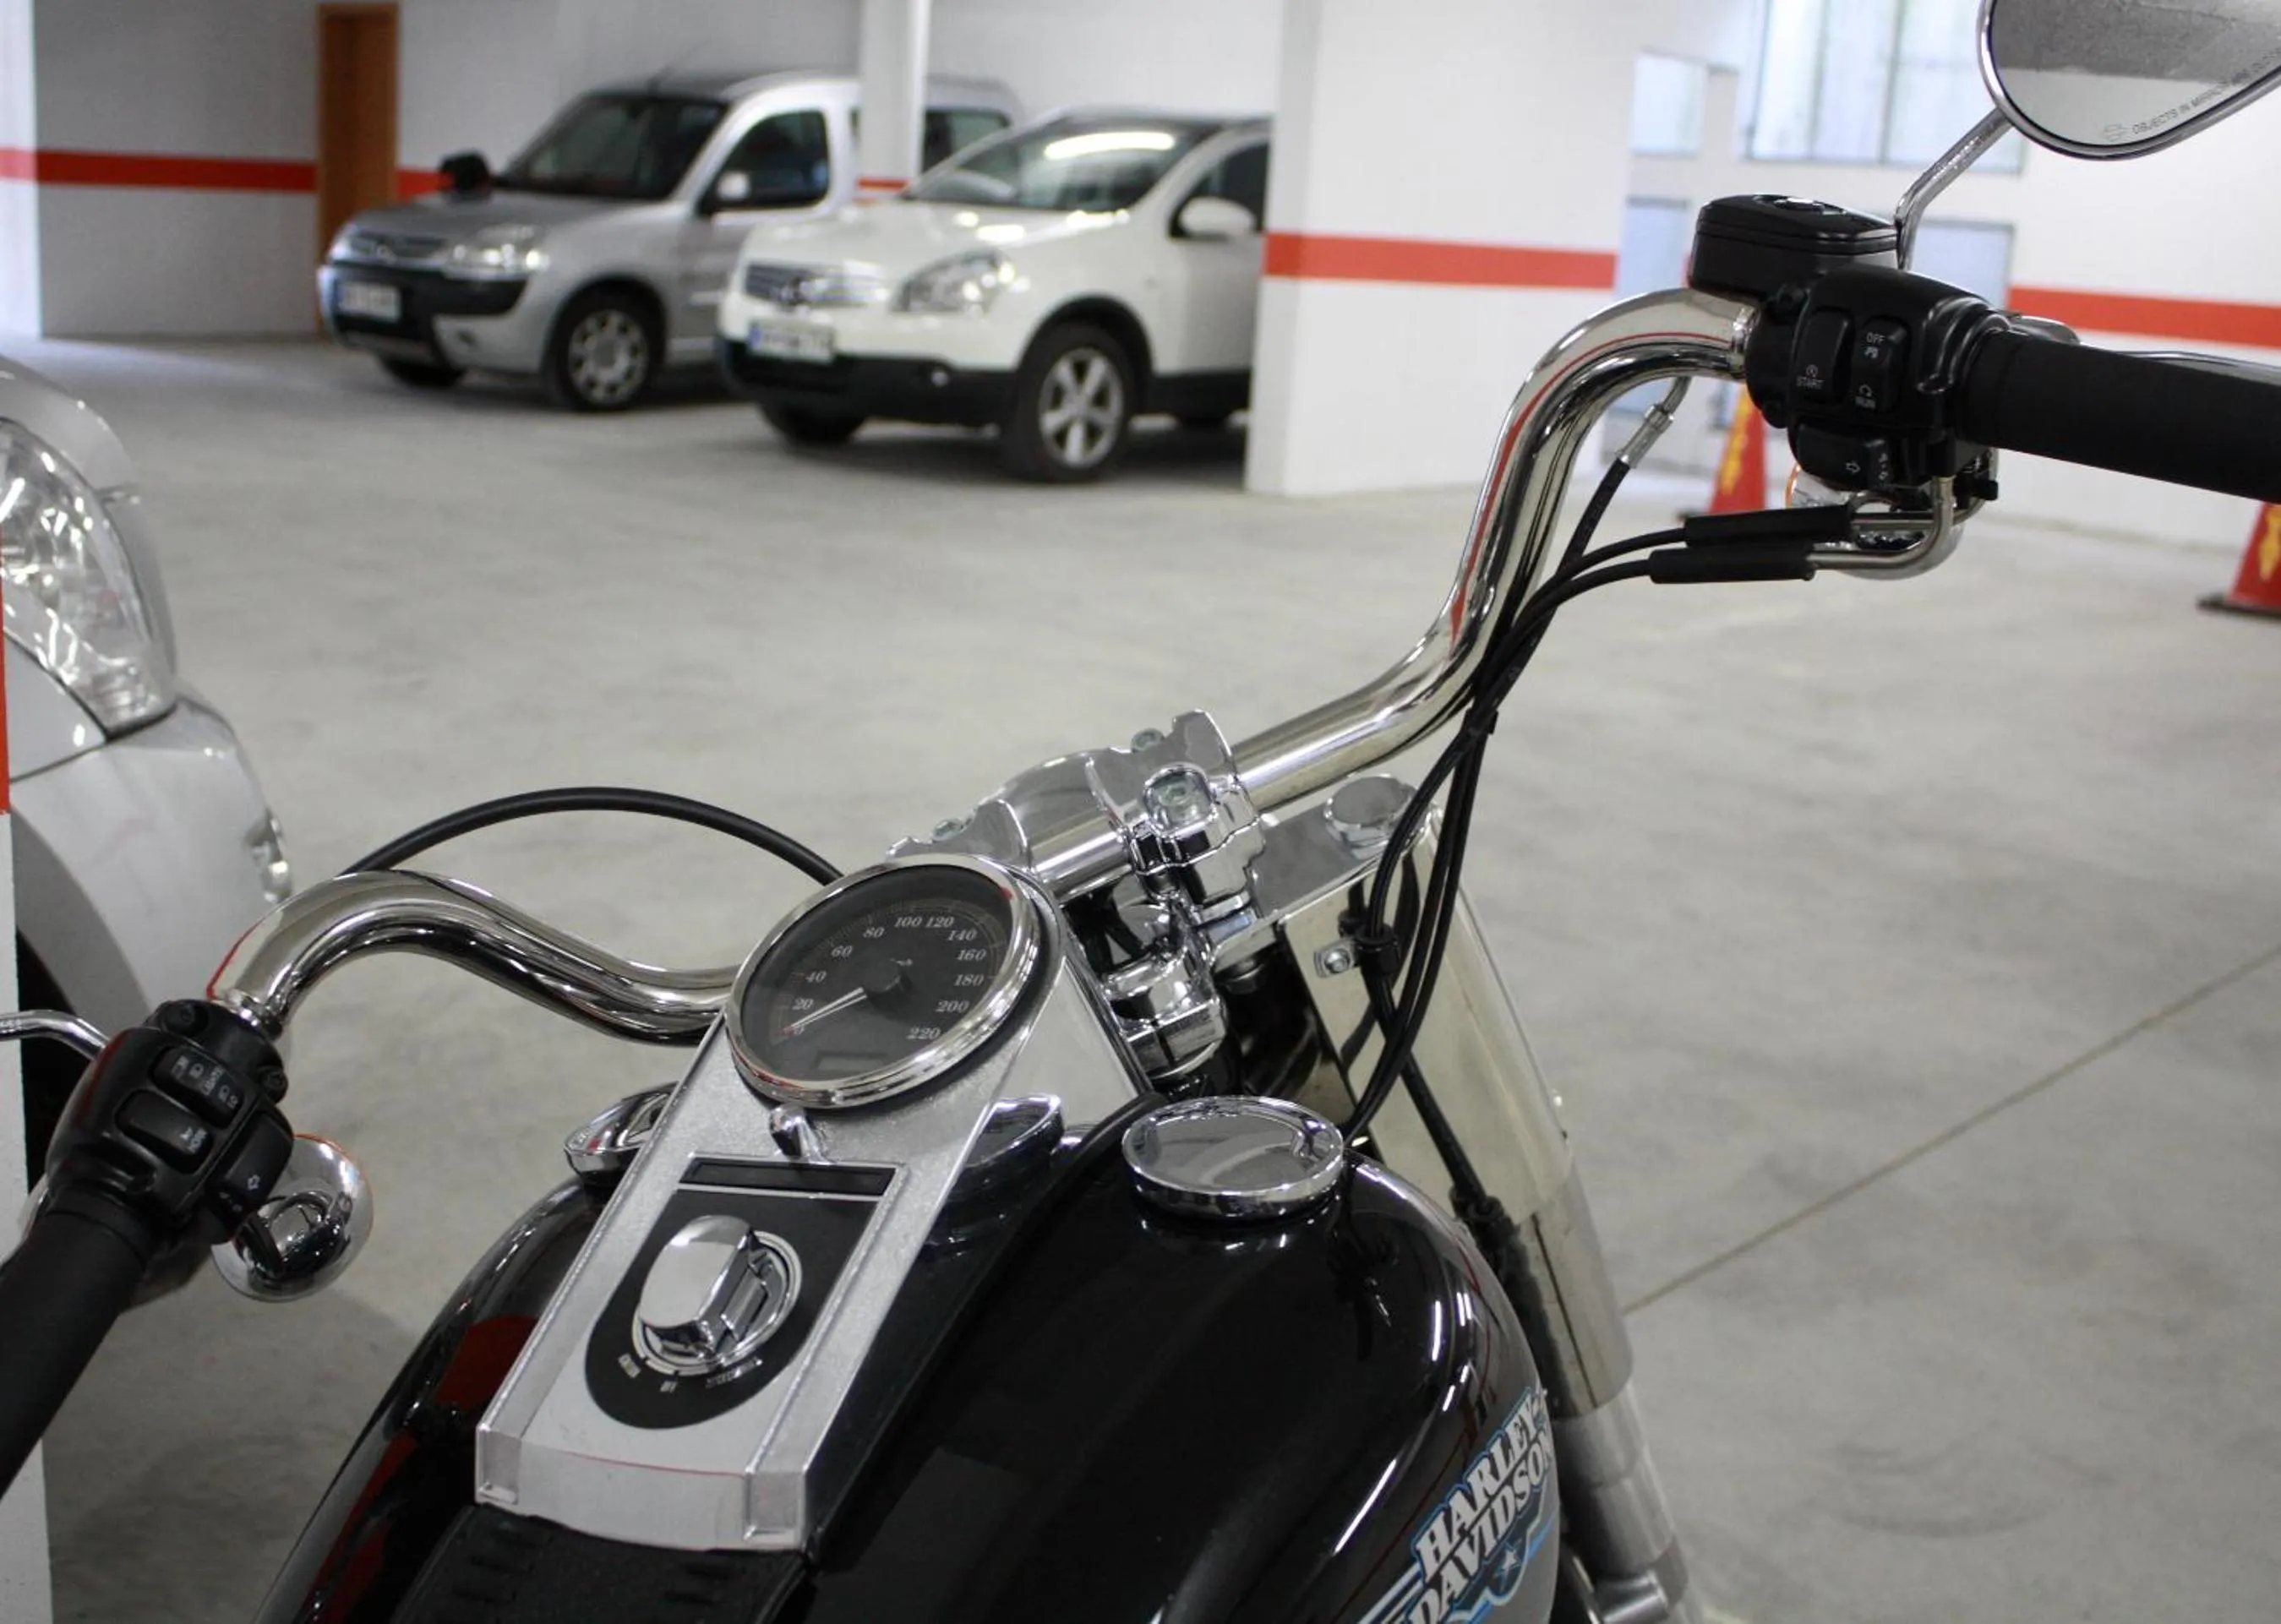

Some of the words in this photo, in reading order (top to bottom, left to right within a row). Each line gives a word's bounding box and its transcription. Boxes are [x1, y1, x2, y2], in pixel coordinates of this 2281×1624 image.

[1866, 332, 1885, 344] OFF
[894, 916, 922, 928] 100
[925, 916, 955, 928] 120
[863, 926, 885, 938] 80
[947, 929, 978, 941] 140
[831, 945, 854, 957] 60
[957, 949, 987, 961] 160
[805, 970, 827, 983] 40
[953, 973, 985, 987] 180
[792, 998, 814, 1011] 20
[936, 1000, 970, 1013] 200
[906, 1027, 941, 1040] 220
[1416, 1393, 1546, 1583] HARLEY
[1407, 1430, 1552, 1624] DAVIDSON
